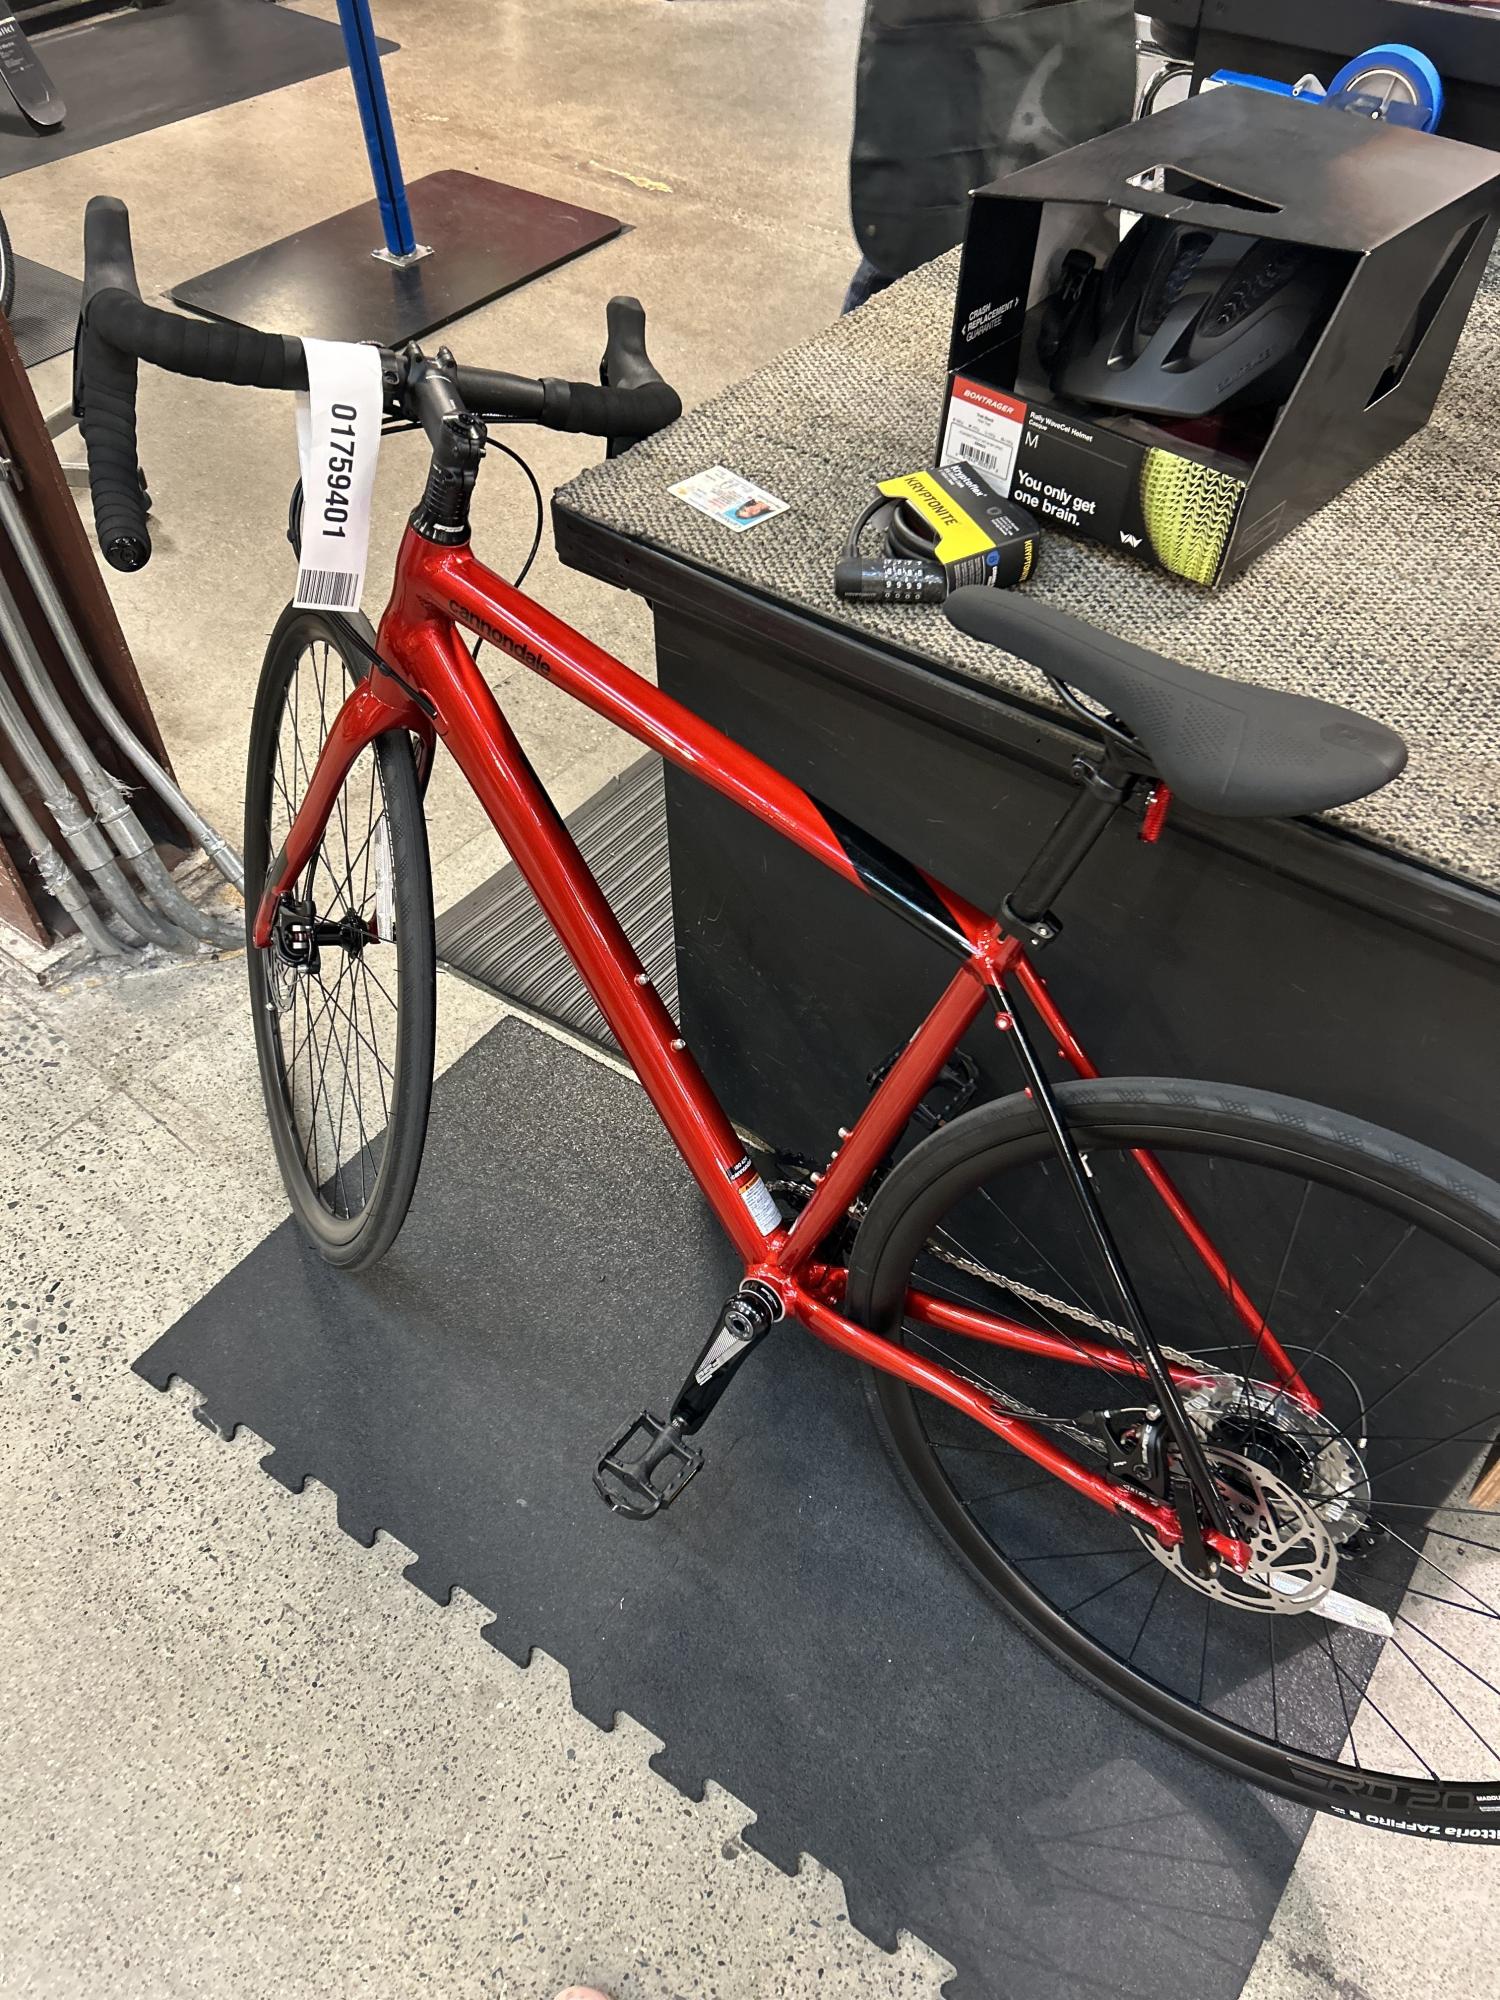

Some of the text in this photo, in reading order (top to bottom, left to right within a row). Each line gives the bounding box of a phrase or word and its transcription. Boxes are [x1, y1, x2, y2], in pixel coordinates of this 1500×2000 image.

[967, 299, 1014, 332] REPLACEMENT
[968, 302, 992, 321] CRASH
[966, 314, 1003, 342] GUARANTEE
[963, 389, 1015, 414] BONTRAGER
[1028, 419, 1048, 431] Casque
[1029, 411, 1094, 443] Rally WaveCel Helmet
[1024, 431, 1040, 449] M
[322, 403, 357, 538] 01759401
[904, 476, 959, 527] KRYPTONITE
[1018, 469, 1097, 515] You only get
[1013, 489, 1040, 508] one
[1041, 499, 1080, 526] brain.
[448, 599, 552, 677] cannondale
[1326, 1777, 1399, 1806] RD
[1365, 1814, 1441, 1835] ZAFFIRO
[1445, 1827, 1500, 1840] ittoria
